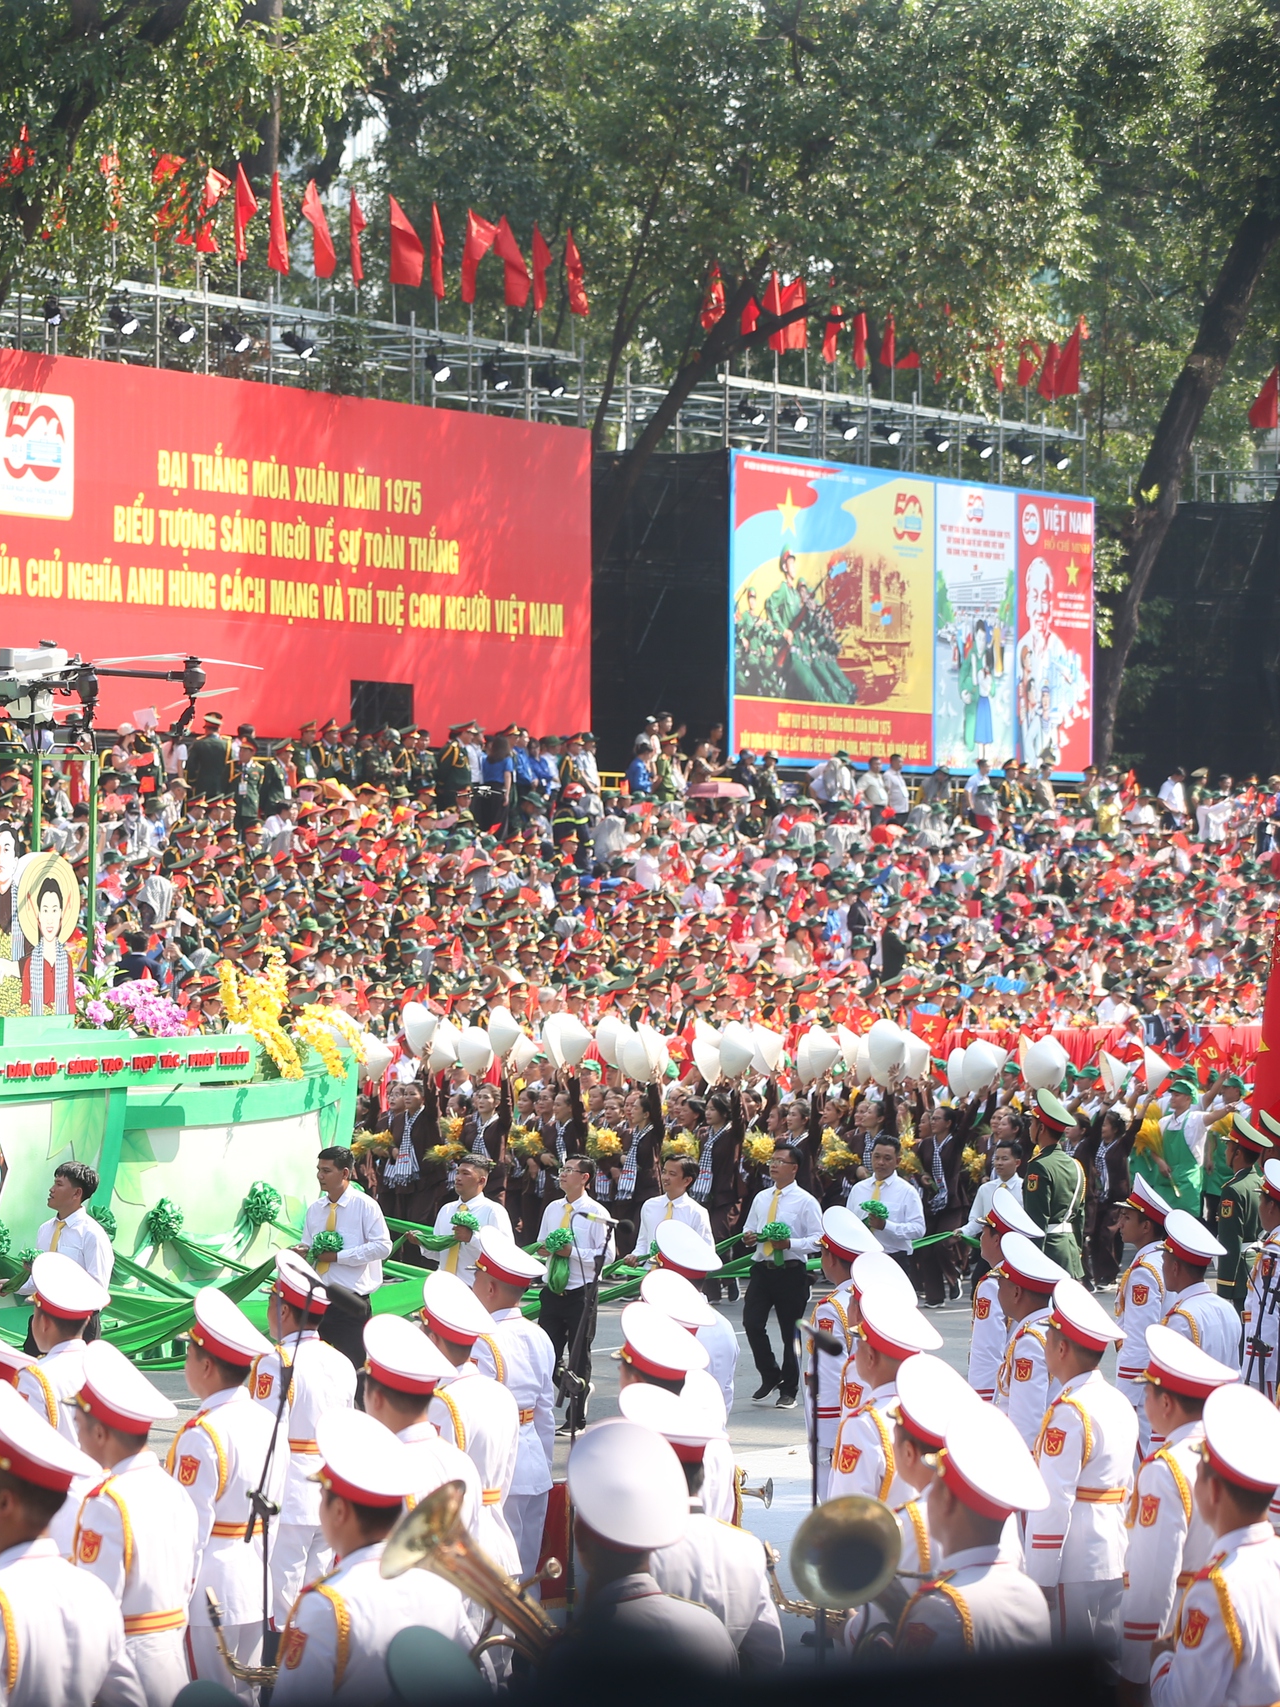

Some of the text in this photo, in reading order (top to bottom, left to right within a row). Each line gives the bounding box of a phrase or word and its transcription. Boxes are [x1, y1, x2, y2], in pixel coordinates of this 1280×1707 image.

[157, 442, 422, 515] ĐẠI THẮNG MÙA XUÂN NĂM 1975
[114, 492, 459, 575] BIỂU TƯỢNG SÁNG NGỜI VỀ SỰ TOÀN THẮNG
[1043, 503, 1067, 535] VIỆT
[1069, 511, 1091, 535] NAM
[26, 548, 63, 599] CHỦ
[67, 557, 123, 603] NGHĨA
[126, 567, 164, 606] ANH
[168, 562, 216, 610] HÙNG
[220, 568, 266, 614] CÁCH
[270, 579, 319, 625] MẠNG
[323, 579, 344, 622] VÀ
[348, 582, 372, 624] TRÍ
[377, 584, 405, 634] TUỆ
[409, 592, 441, 629] CON
[445, 589, 491, 633] NGƯỜI
[495, 593, 526, 641] VIỆT
[529, 601, 563, 637] NAM
[6, 1060, 32, 1079] DÂN
[34, 1057, 58, 1077] CHỦ
[67, 1056, 99, 1075] SÁNG
[101, 1057, 124, 1076] TẠO
[131, 1054, 157, 1074] HỢP
[160, 1051, 181, 1069] TÁC
[187, 1049, 217, 1068] PHÁT
[219, 1045, 250, 1066] TRIỂN
